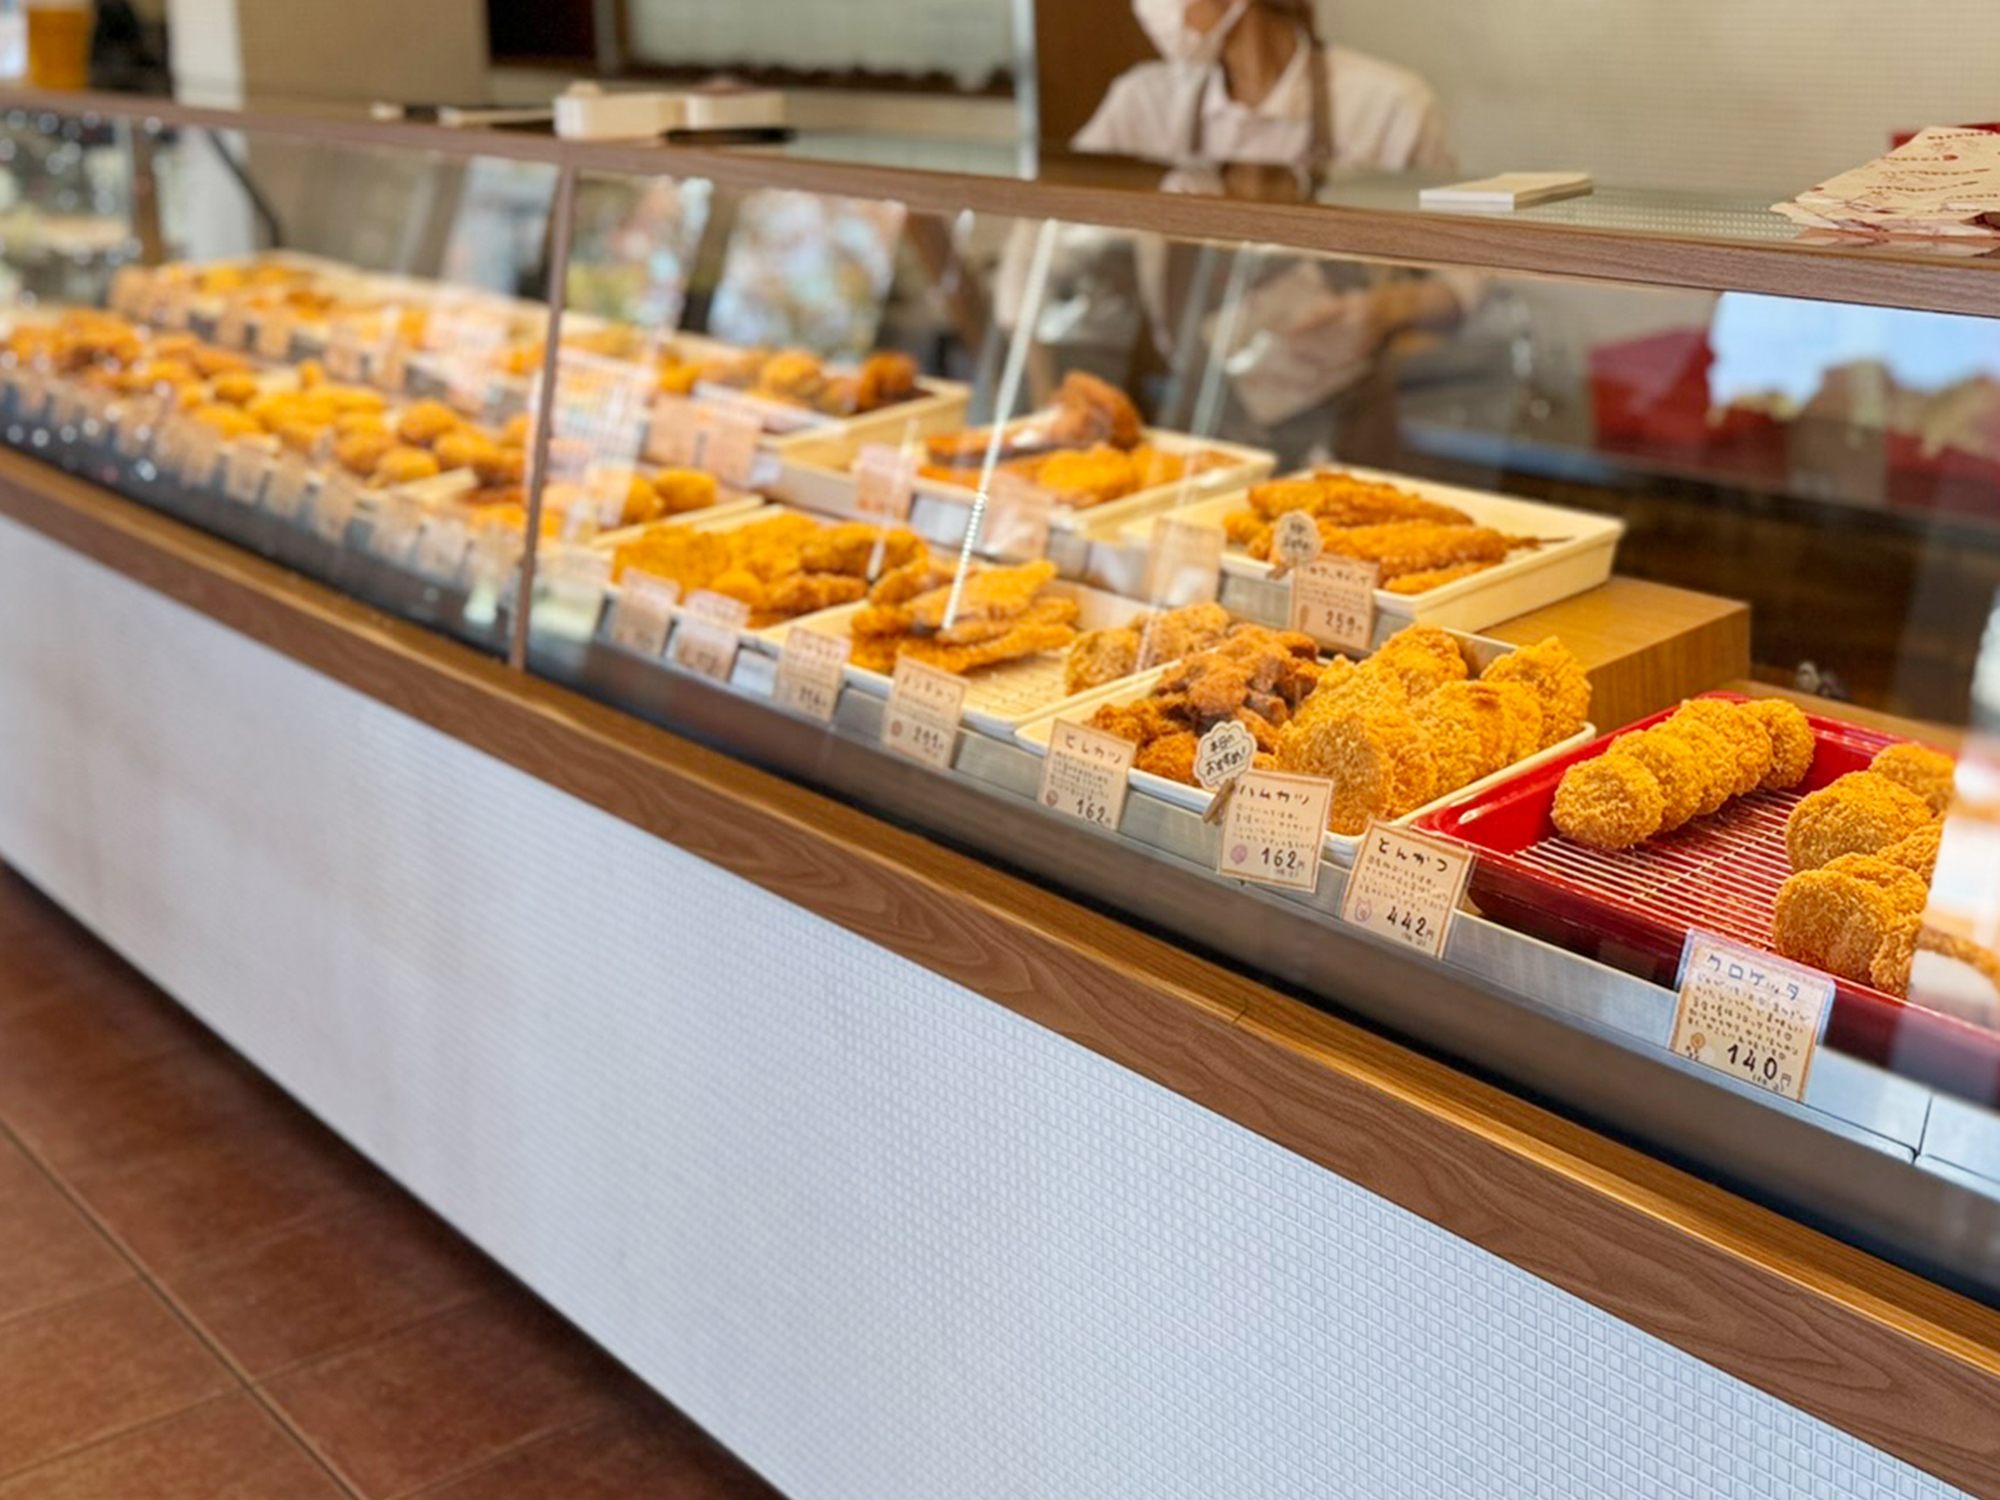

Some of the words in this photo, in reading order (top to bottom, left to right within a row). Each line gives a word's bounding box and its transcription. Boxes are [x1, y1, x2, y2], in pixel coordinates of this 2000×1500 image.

[1239, 785, 1310, 806] ハムカツ
[1378, 837, 1448, 872] とんかつ
